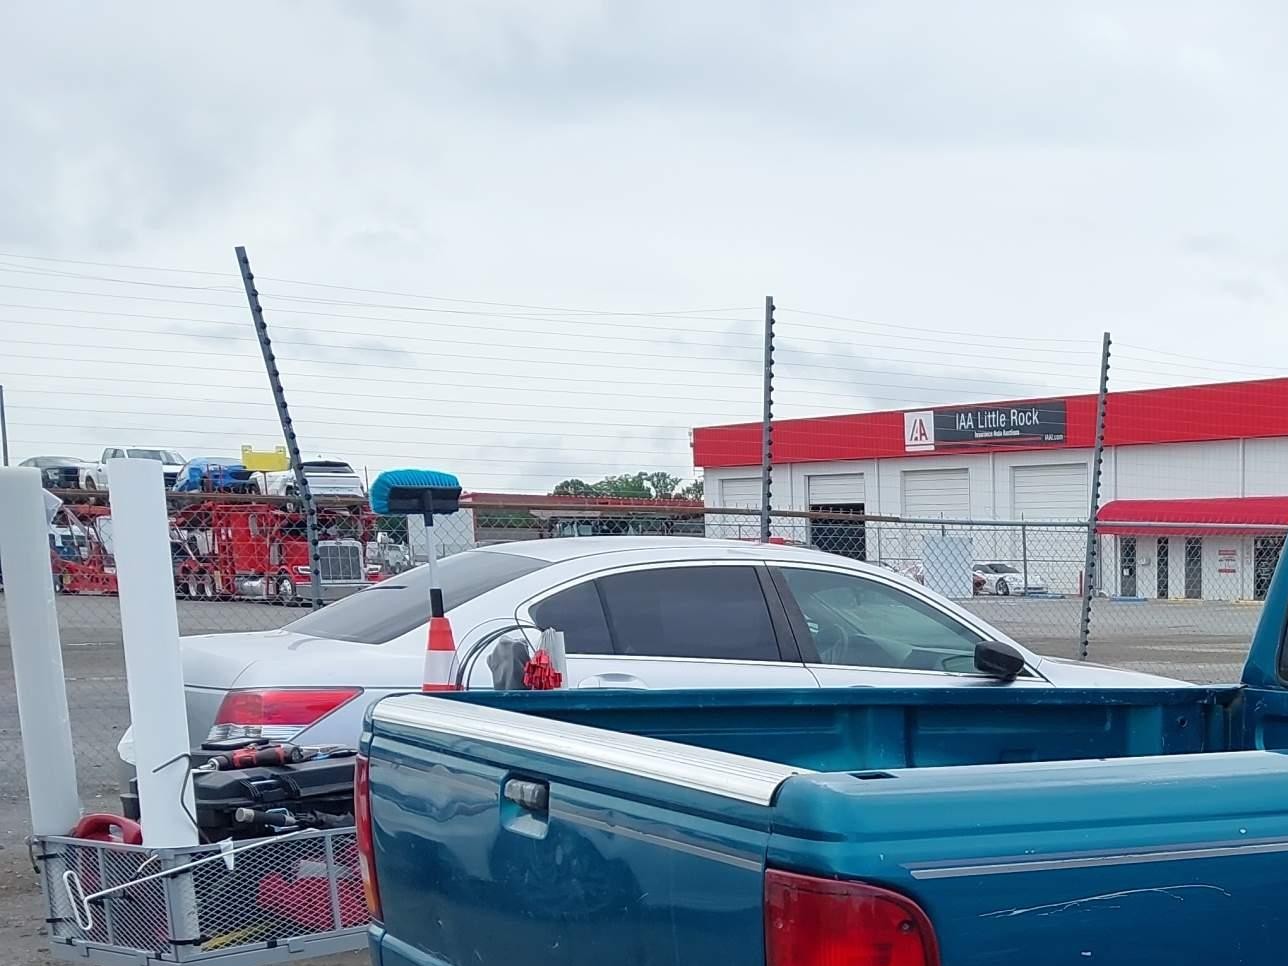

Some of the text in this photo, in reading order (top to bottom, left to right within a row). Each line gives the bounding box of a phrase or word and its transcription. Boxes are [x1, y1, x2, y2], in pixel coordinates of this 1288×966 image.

[956, 408, 1040, 430] IAA Little Rock
